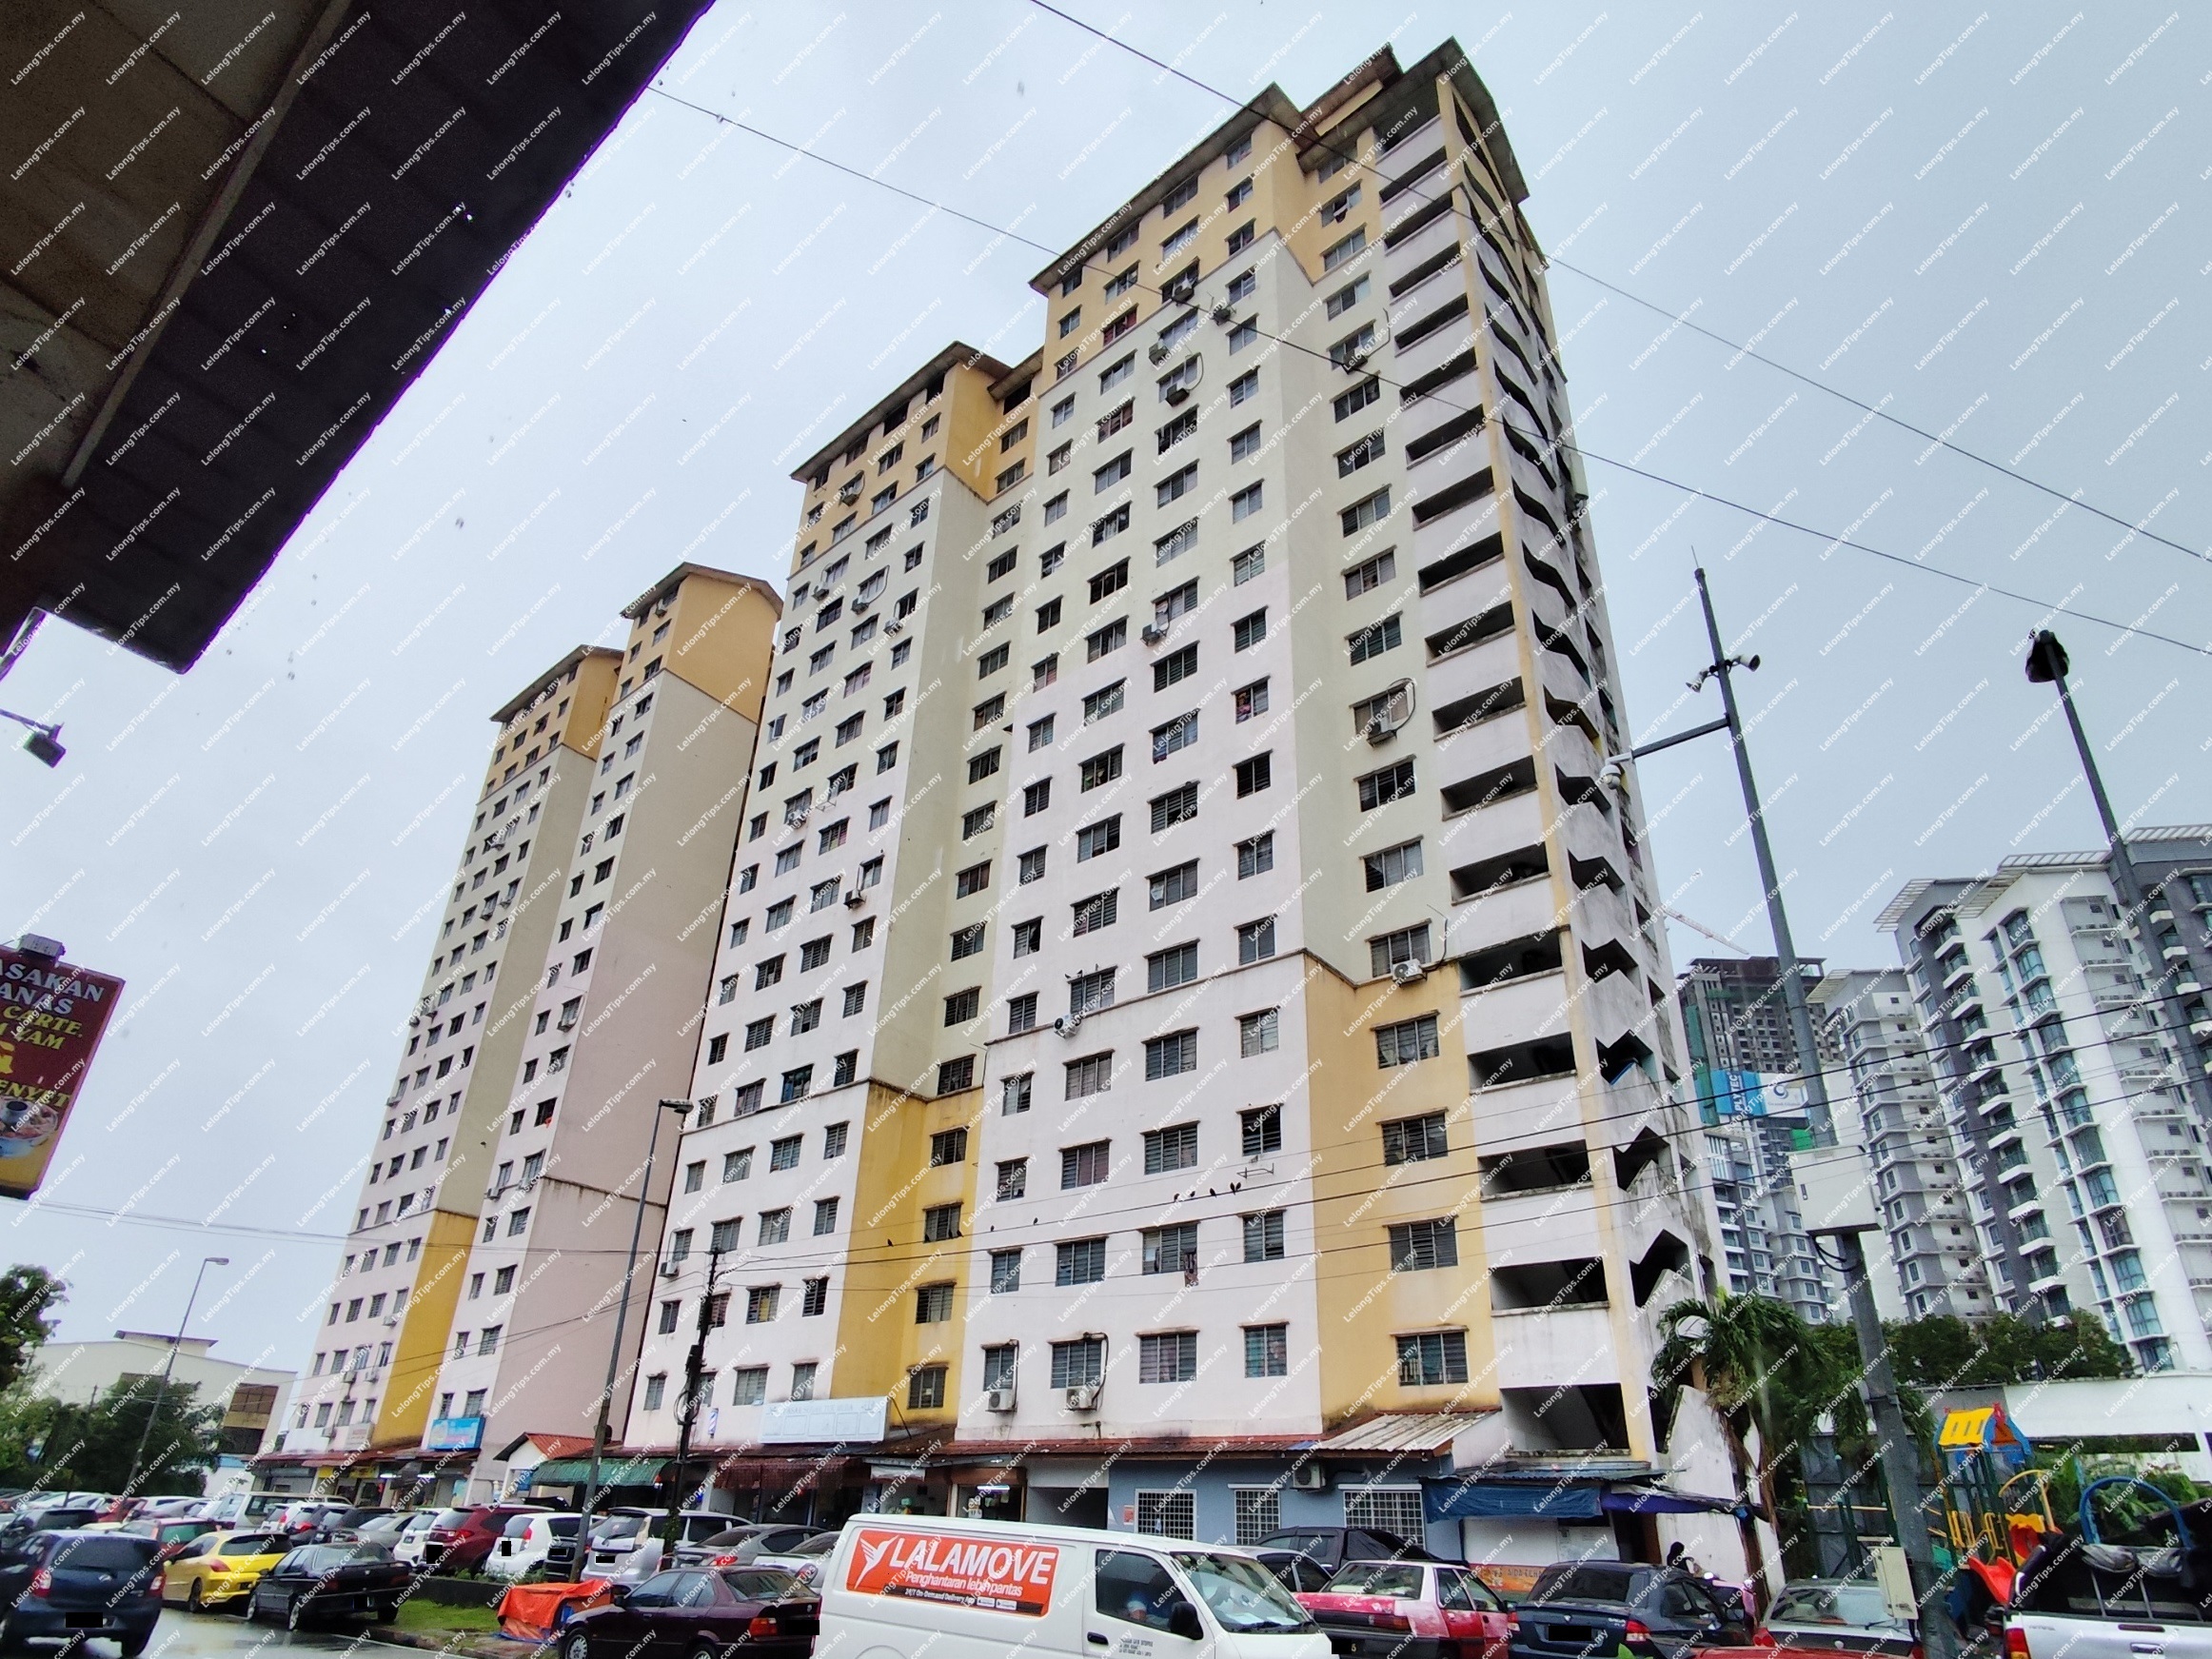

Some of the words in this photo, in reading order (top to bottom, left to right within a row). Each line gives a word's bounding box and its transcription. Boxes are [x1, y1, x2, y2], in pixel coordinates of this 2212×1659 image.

[0, 958, 104, 1002] SAKAN
[1728, 1074, 1743, 1112] PLYTEC
[889, 1536, 1057, 1585] LALAMOVE
[905, 1570, 966, 1590] Penghantaran
[967, 1577, 990, 1592] lebih
[989, 1583, 1023, 1597] pantas
